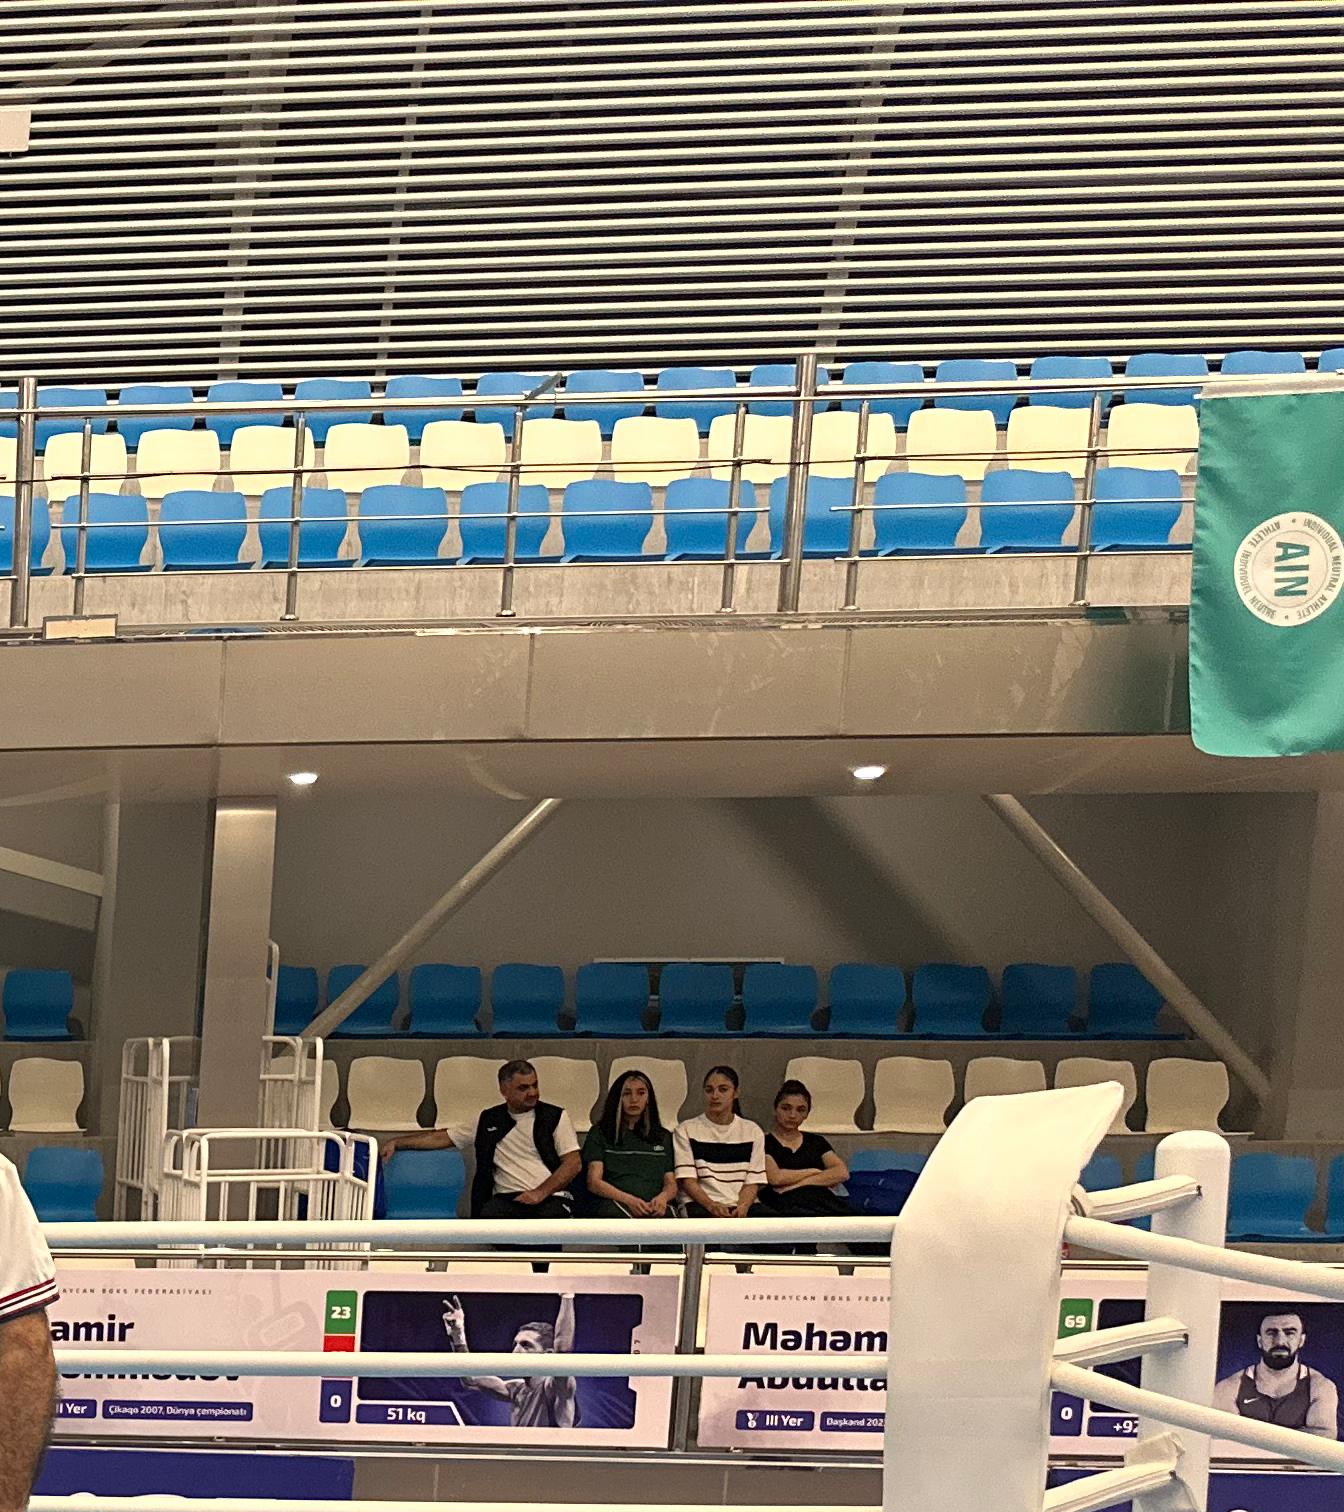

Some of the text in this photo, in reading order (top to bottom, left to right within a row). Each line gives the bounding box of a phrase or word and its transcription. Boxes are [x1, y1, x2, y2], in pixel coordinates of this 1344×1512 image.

[1274, 541, 1310, 597] AIN
[1297, 594, 1328, 620] ATHLETE
[330, 1306, 352, 1319] 23
[50, 1313, 135, 1342] amir
[1064, 1315, 1087, 1329] 69
[330, 1395, 342, 1408] 0
[65, 1402, 88, 1415] Yer
[140, 1405, 165, 1415] 2007,
[166, 1405, 194, 1417] Dünya
[1060, 1406, 1073, 1420] 0
[386, 1406, 426, 1425] 51 kq
[781, 1415, 804, 1427] Yer
[866, 1417, 885, 1427] 202
